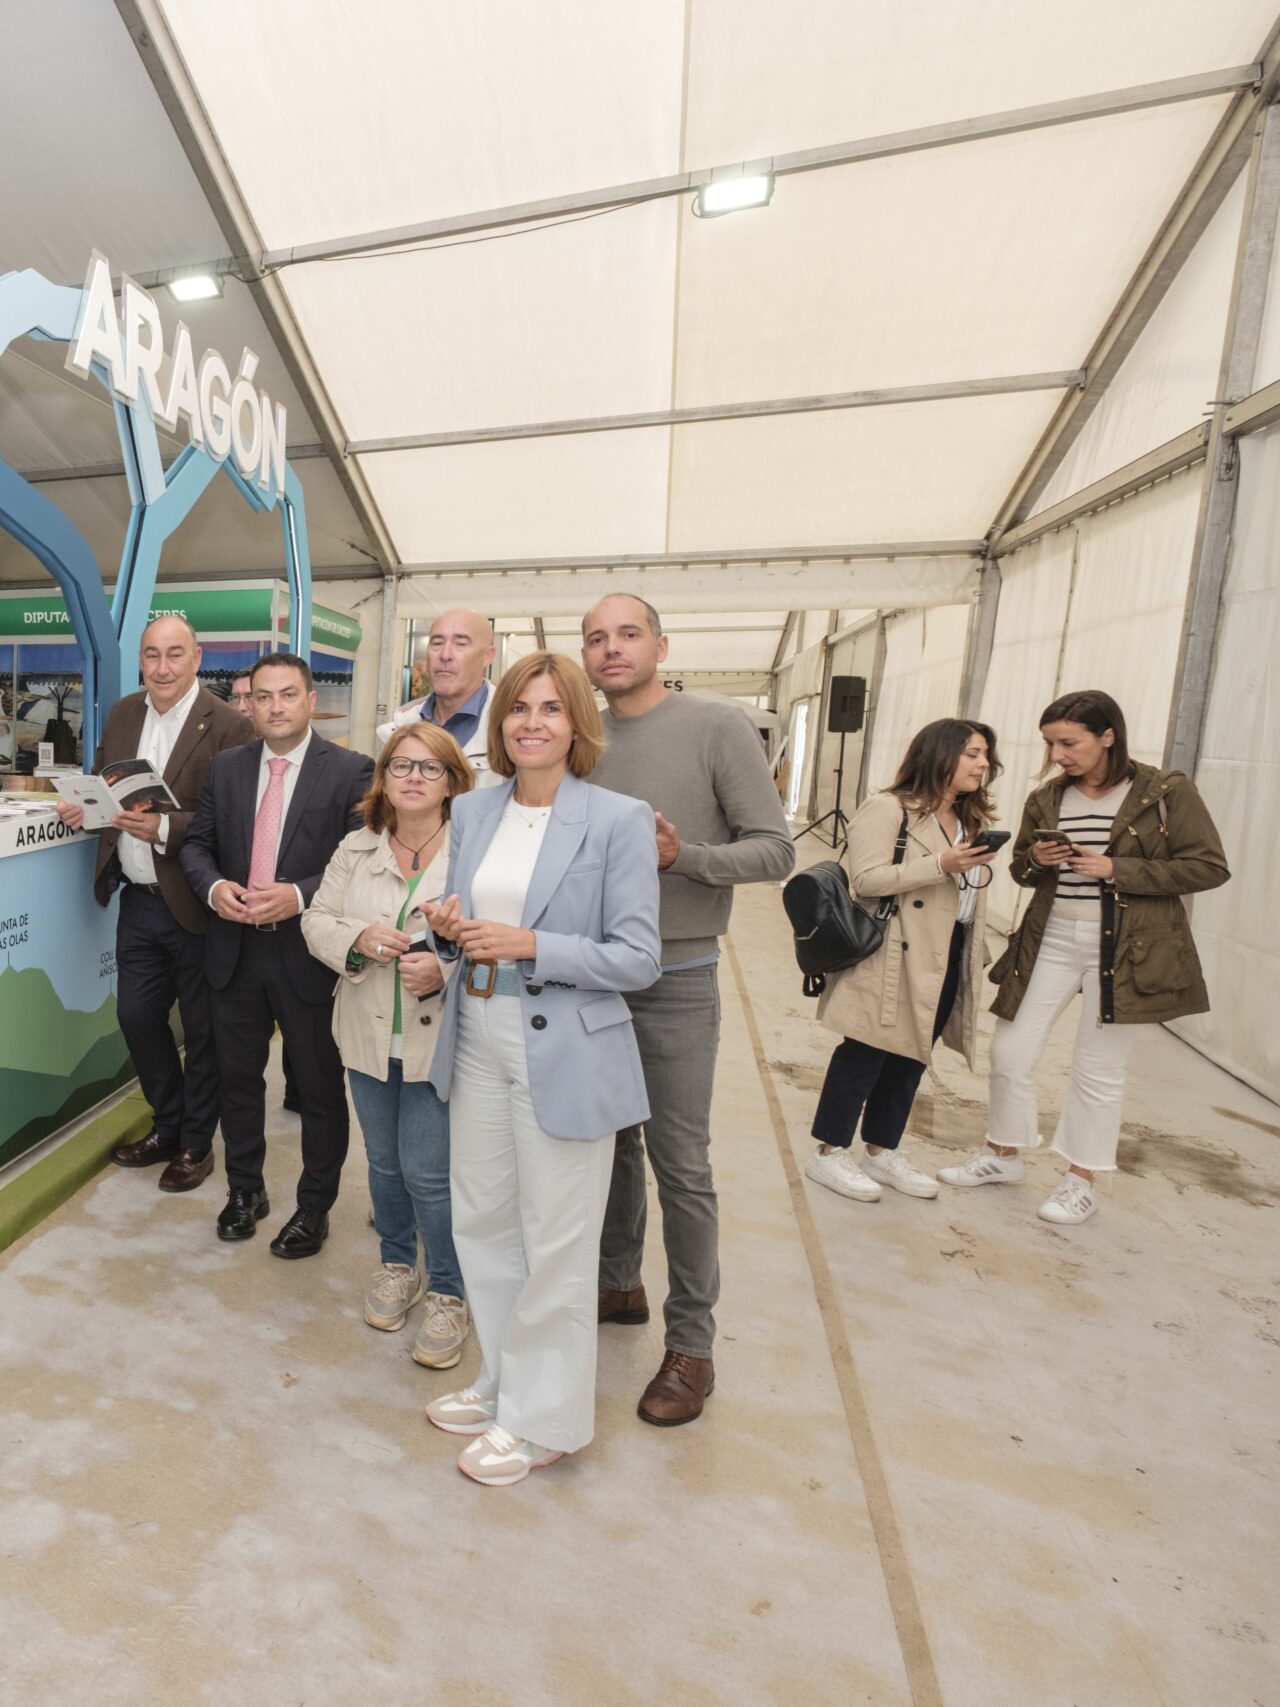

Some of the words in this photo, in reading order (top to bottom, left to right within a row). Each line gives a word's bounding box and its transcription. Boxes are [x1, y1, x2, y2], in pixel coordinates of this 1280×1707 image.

[65, 248, 287, 500] ARAGÓN
[24, 612, 69, 624] DIPUTA
[19, 913, 29, 927] DE
[8, 931, 29, 947] OLAS
